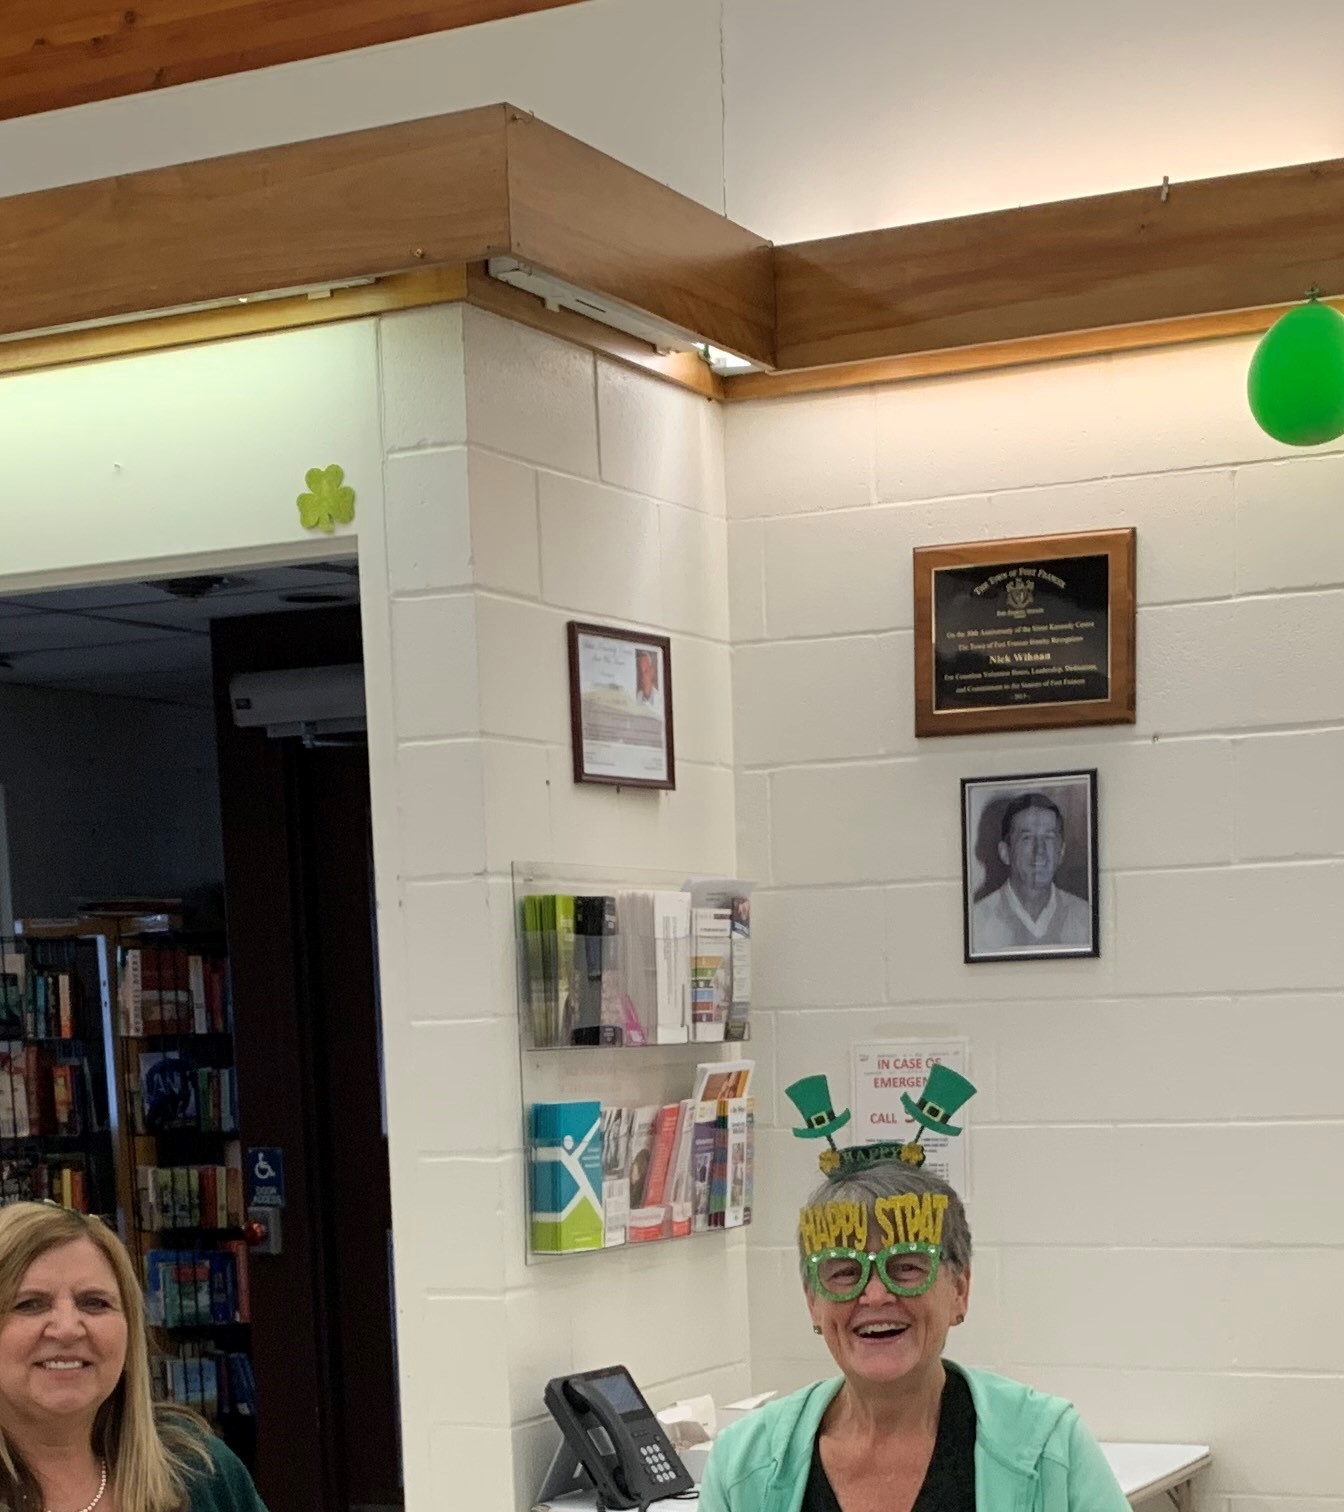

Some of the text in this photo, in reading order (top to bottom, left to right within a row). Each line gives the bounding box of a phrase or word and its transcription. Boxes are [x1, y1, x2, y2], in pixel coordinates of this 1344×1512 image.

[989, 655, 1011, 664] Nick
[877, 1059, 890, 1070] IN
[893, 1058, 923, 1070] CASE
[870, 1112, 897, 1124] CALL
[800, 1200, 868, 1254] HAPPY
